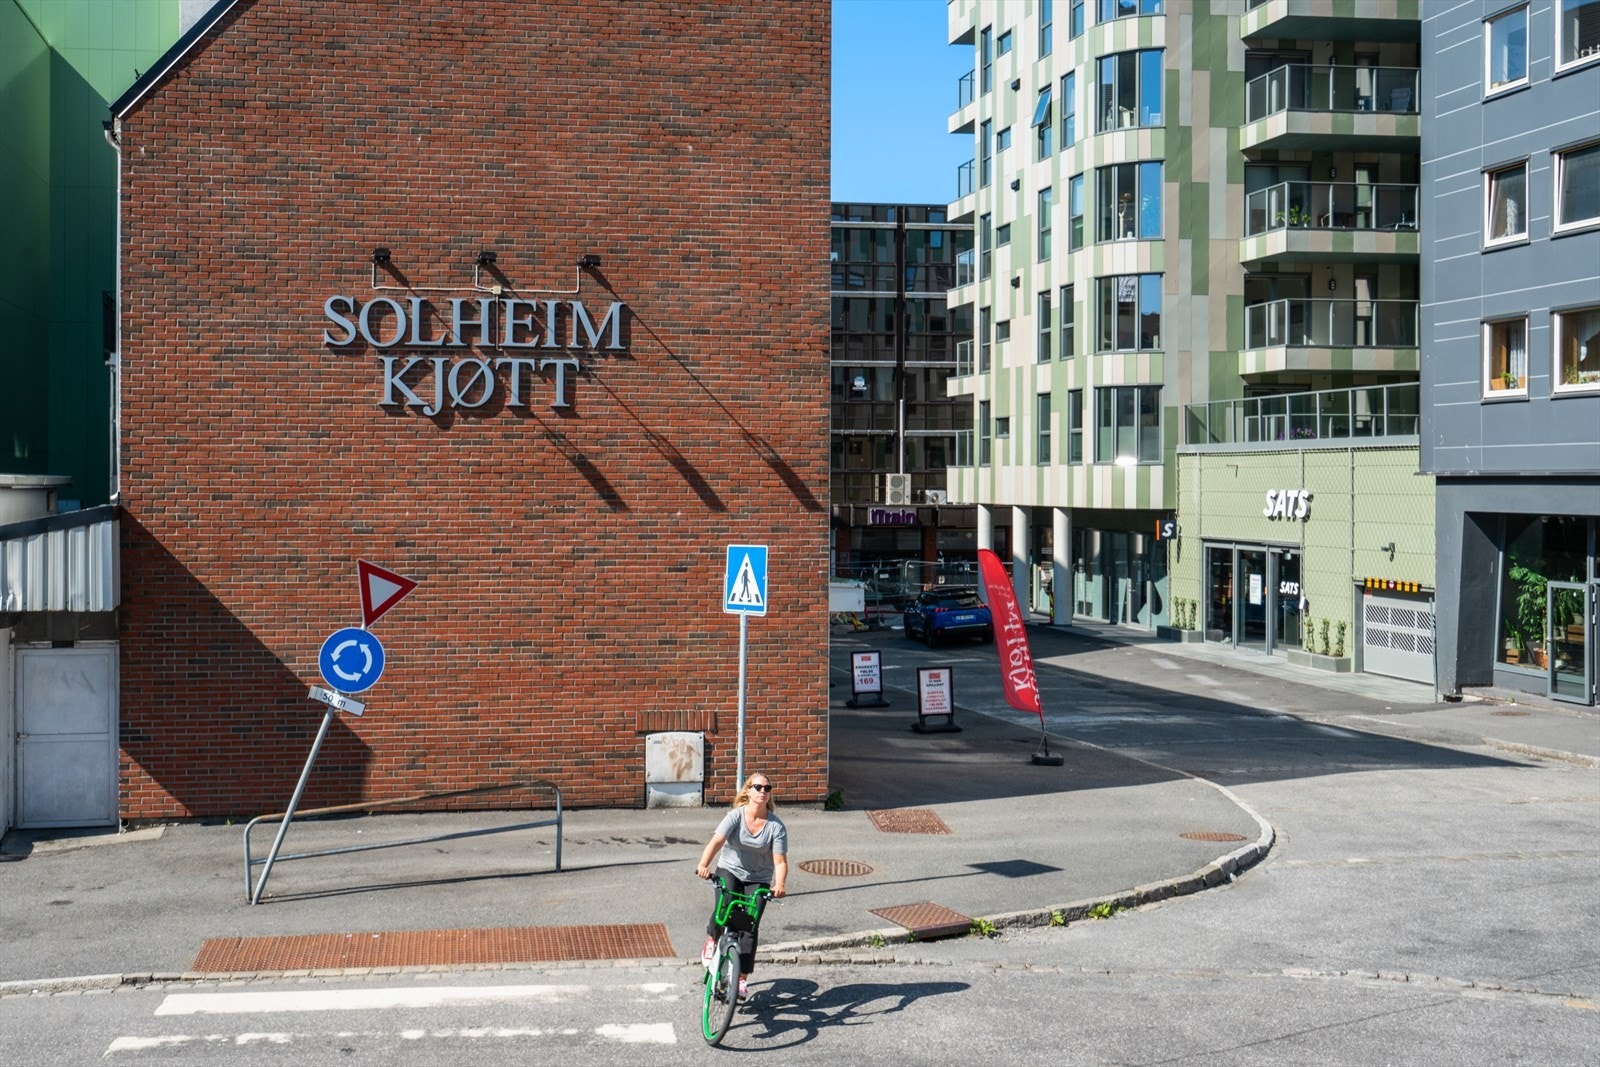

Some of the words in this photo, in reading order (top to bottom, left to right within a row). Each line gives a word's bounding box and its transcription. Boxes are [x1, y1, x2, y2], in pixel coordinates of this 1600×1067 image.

[323, 294, 626, 350] SOLHEIM
[378, 356, 580, 417] KJØTT
[1263, 489, 1311, 519] SATS
[870, 508, 916, 525] iTrain
[1280, 581, 1299, 595] SATS
[322, 692, 333, 703] 50
[337, 699, 346, 707] m
